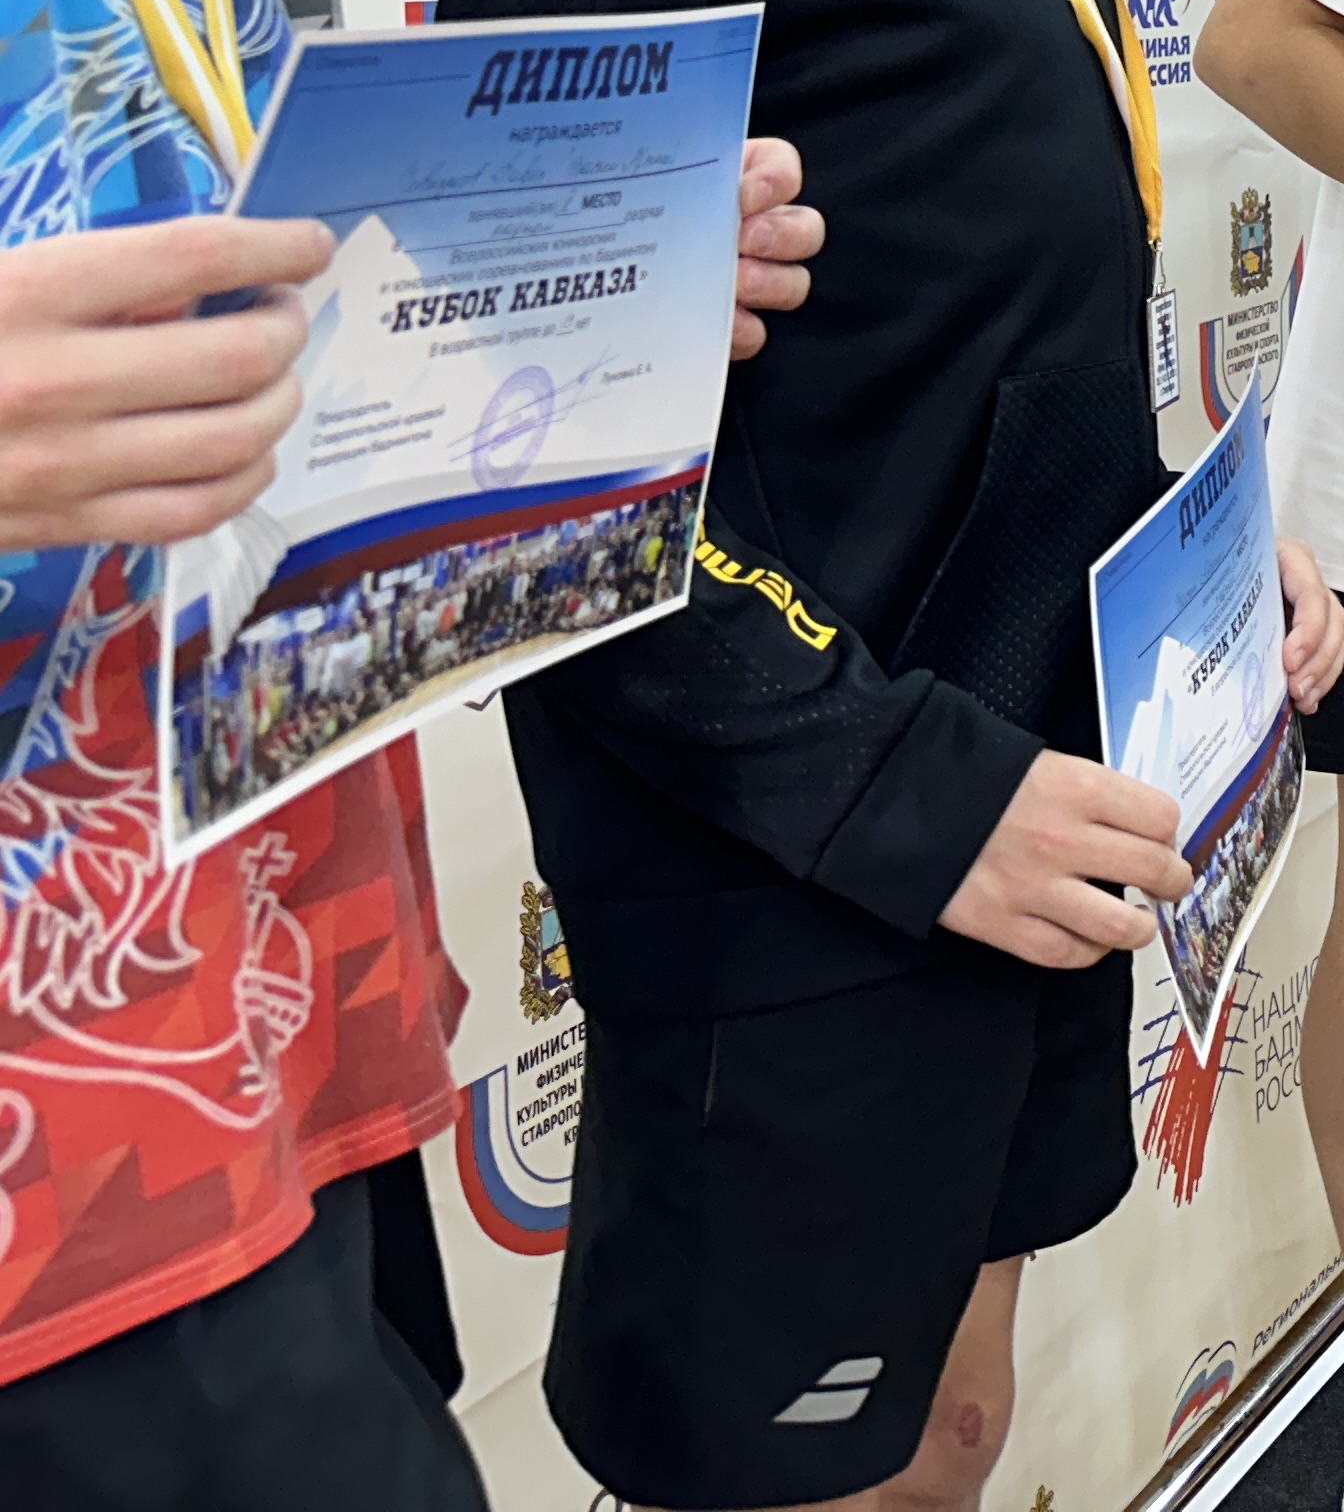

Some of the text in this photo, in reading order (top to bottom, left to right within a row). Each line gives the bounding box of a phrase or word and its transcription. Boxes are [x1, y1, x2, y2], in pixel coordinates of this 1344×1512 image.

[1140, 35, 1191, 59] ИНАЯ
[1148, 61, 1191, 87] ССИЯ
[465, 40, 675, 119] ДИПЛОМ
[379, 285, 504, 335] «КУБОК
[508, 263, 648, 313] КАВКАЗА»
[1178, 424, 1246, 550] ДИПЛОМ
[517, 1021, 587, 1076] МИНИСТЕ
[536, 1051, 584, 1089] ФИЗИЧЕ
[516, 1078, 577, 1126] КУЛЬТУРЫ
[1256, 1056, 1301, 1125] РОСС
[521, 1100, 582, 1147] СТАВРОПО
[1252, 1256, 1343, 1357] Региональн
